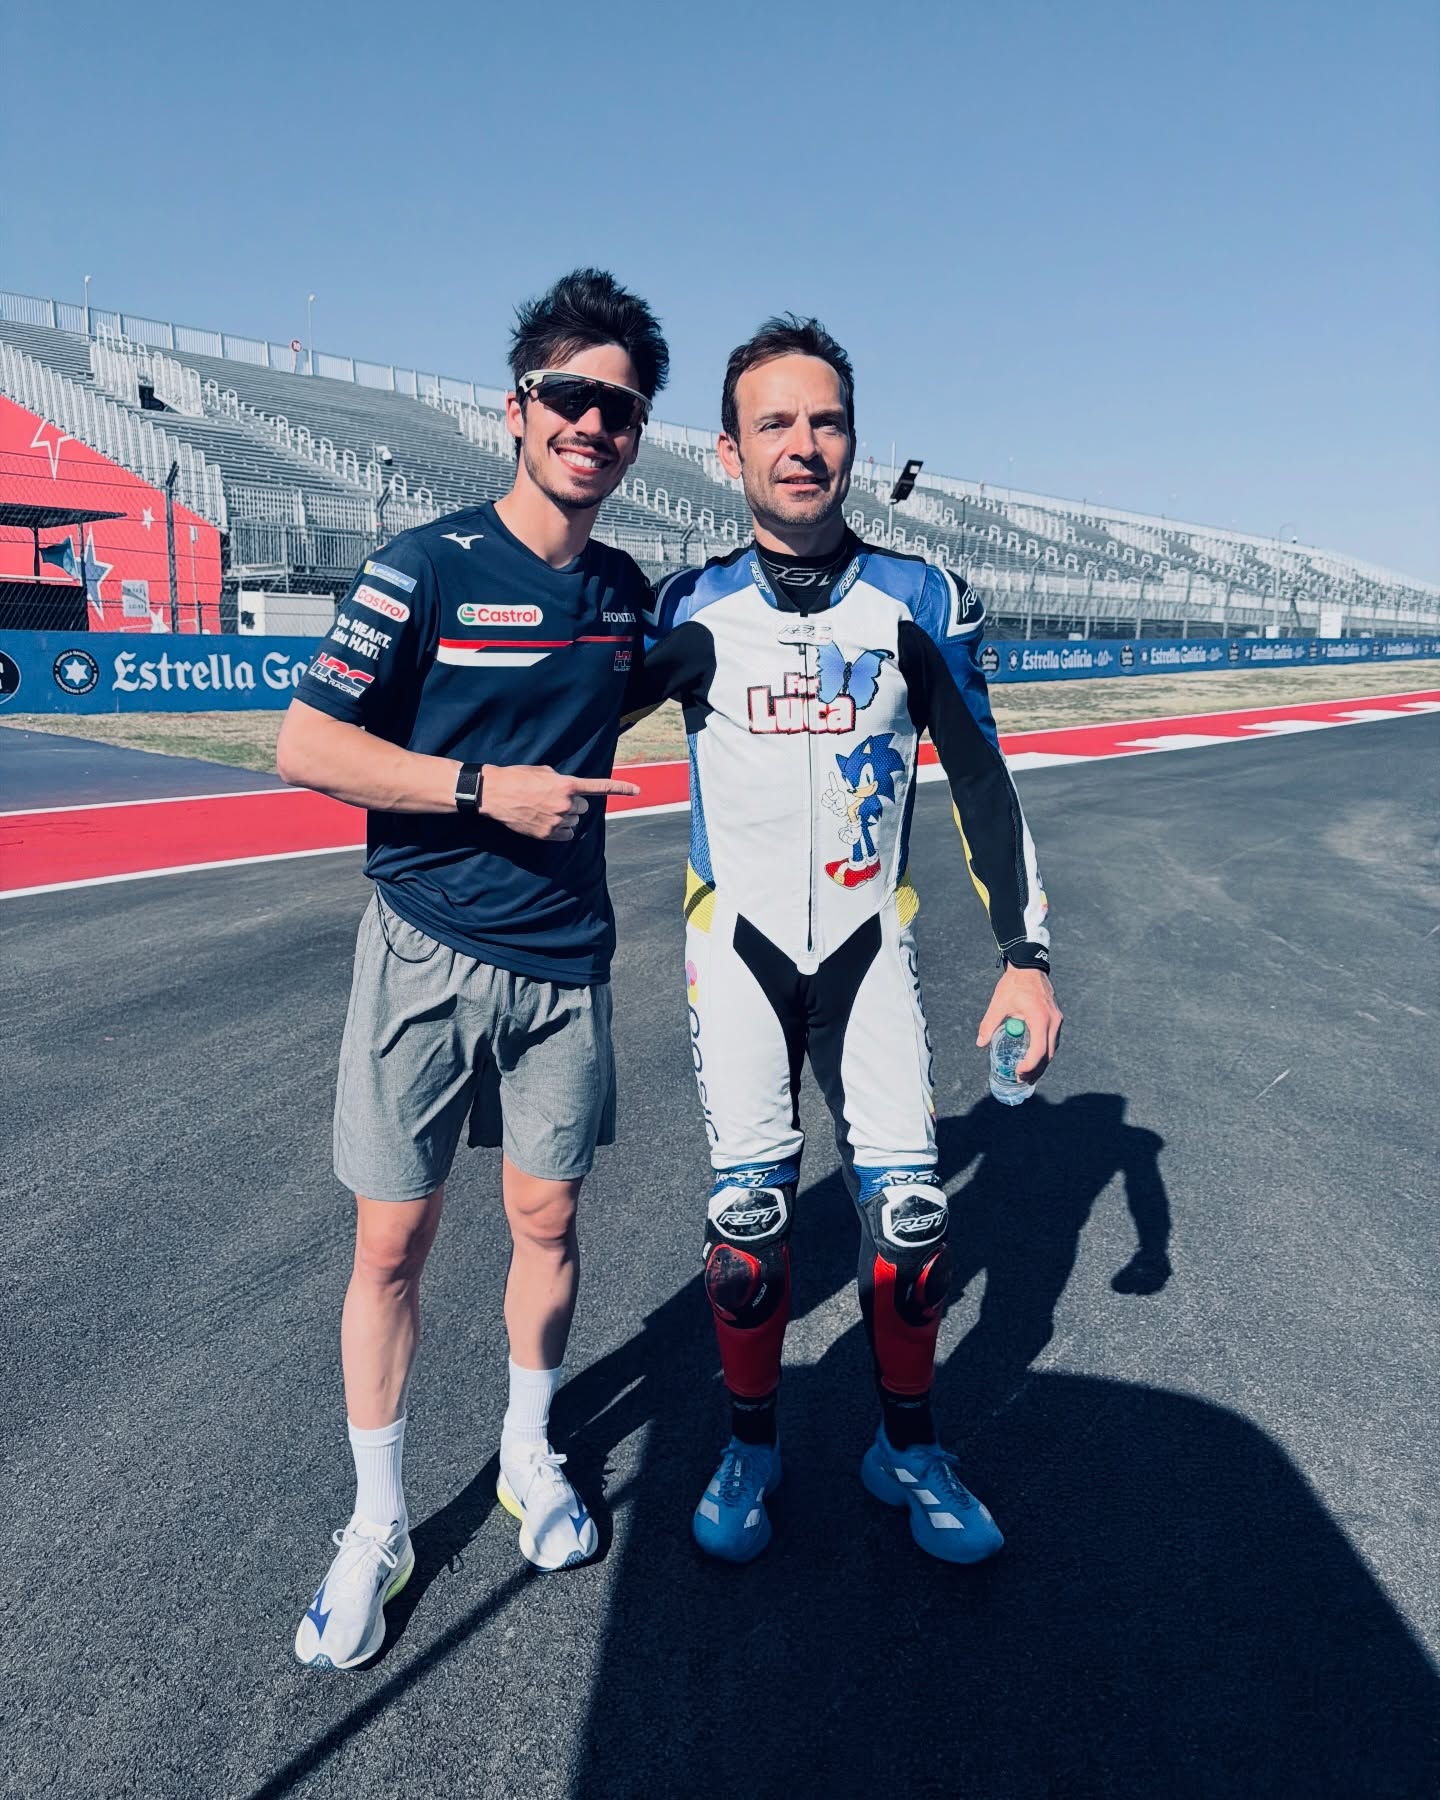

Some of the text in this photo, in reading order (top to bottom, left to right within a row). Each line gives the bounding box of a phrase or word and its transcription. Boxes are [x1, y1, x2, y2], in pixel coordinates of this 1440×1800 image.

[749, 561, 771, 594] RST
[839, 556, 860, 598] RST
[356, 588, 406, 619] Castrol
[477, 607, 537, 623] Castrol
[602, 611, 637, 623] HONDA
[350, 619, 393, 650] HEART.
[112, 651, 257, 692] Estrella
[1021, 649, 1060, 670] Estrella
[1060, 648, 1093, 669] Galicia
[747, 685, 857, 735] Luca
[718, 1204, 780, 1226] RST
[891, 1208, 948, 1234] RST
